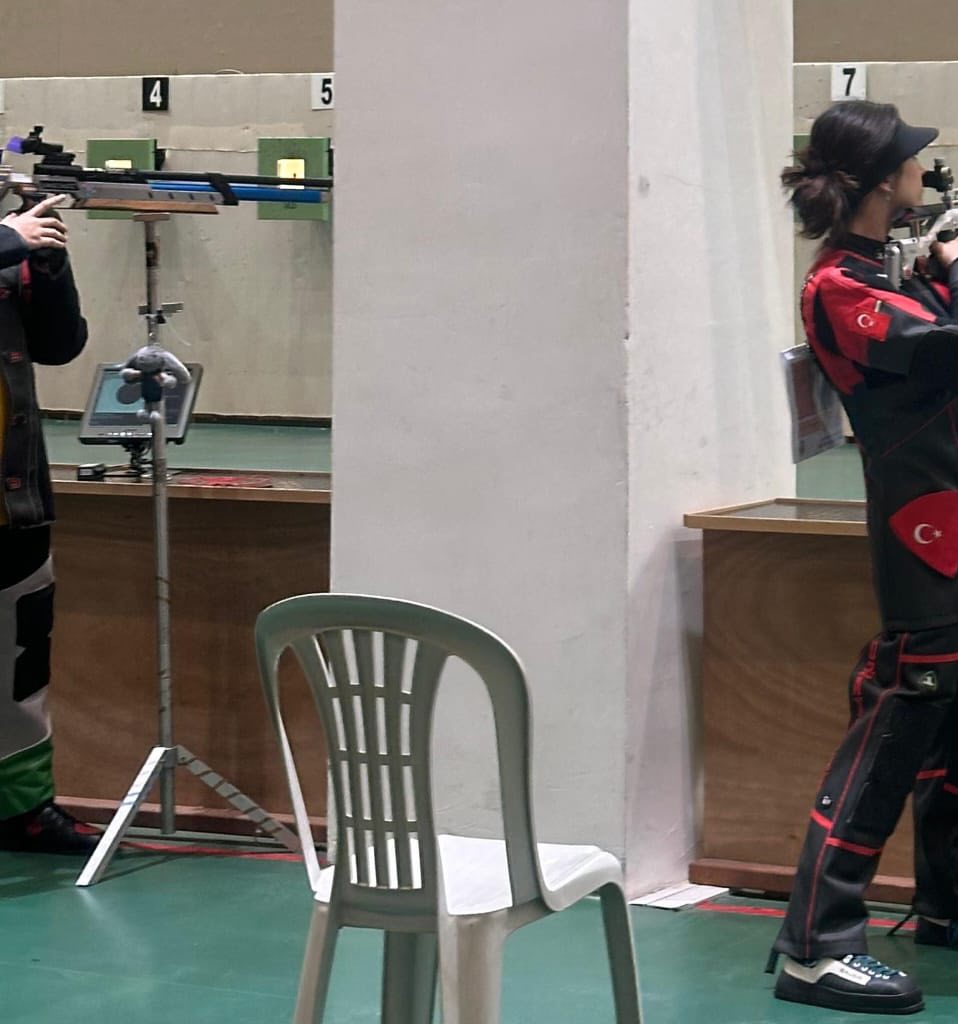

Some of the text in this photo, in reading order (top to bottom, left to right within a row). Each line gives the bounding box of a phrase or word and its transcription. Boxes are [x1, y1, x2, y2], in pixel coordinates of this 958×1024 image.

[149, 81, 162, 107] 4
[320, 79, 333, 105] 5
[842, 68, 856, 97] 7
